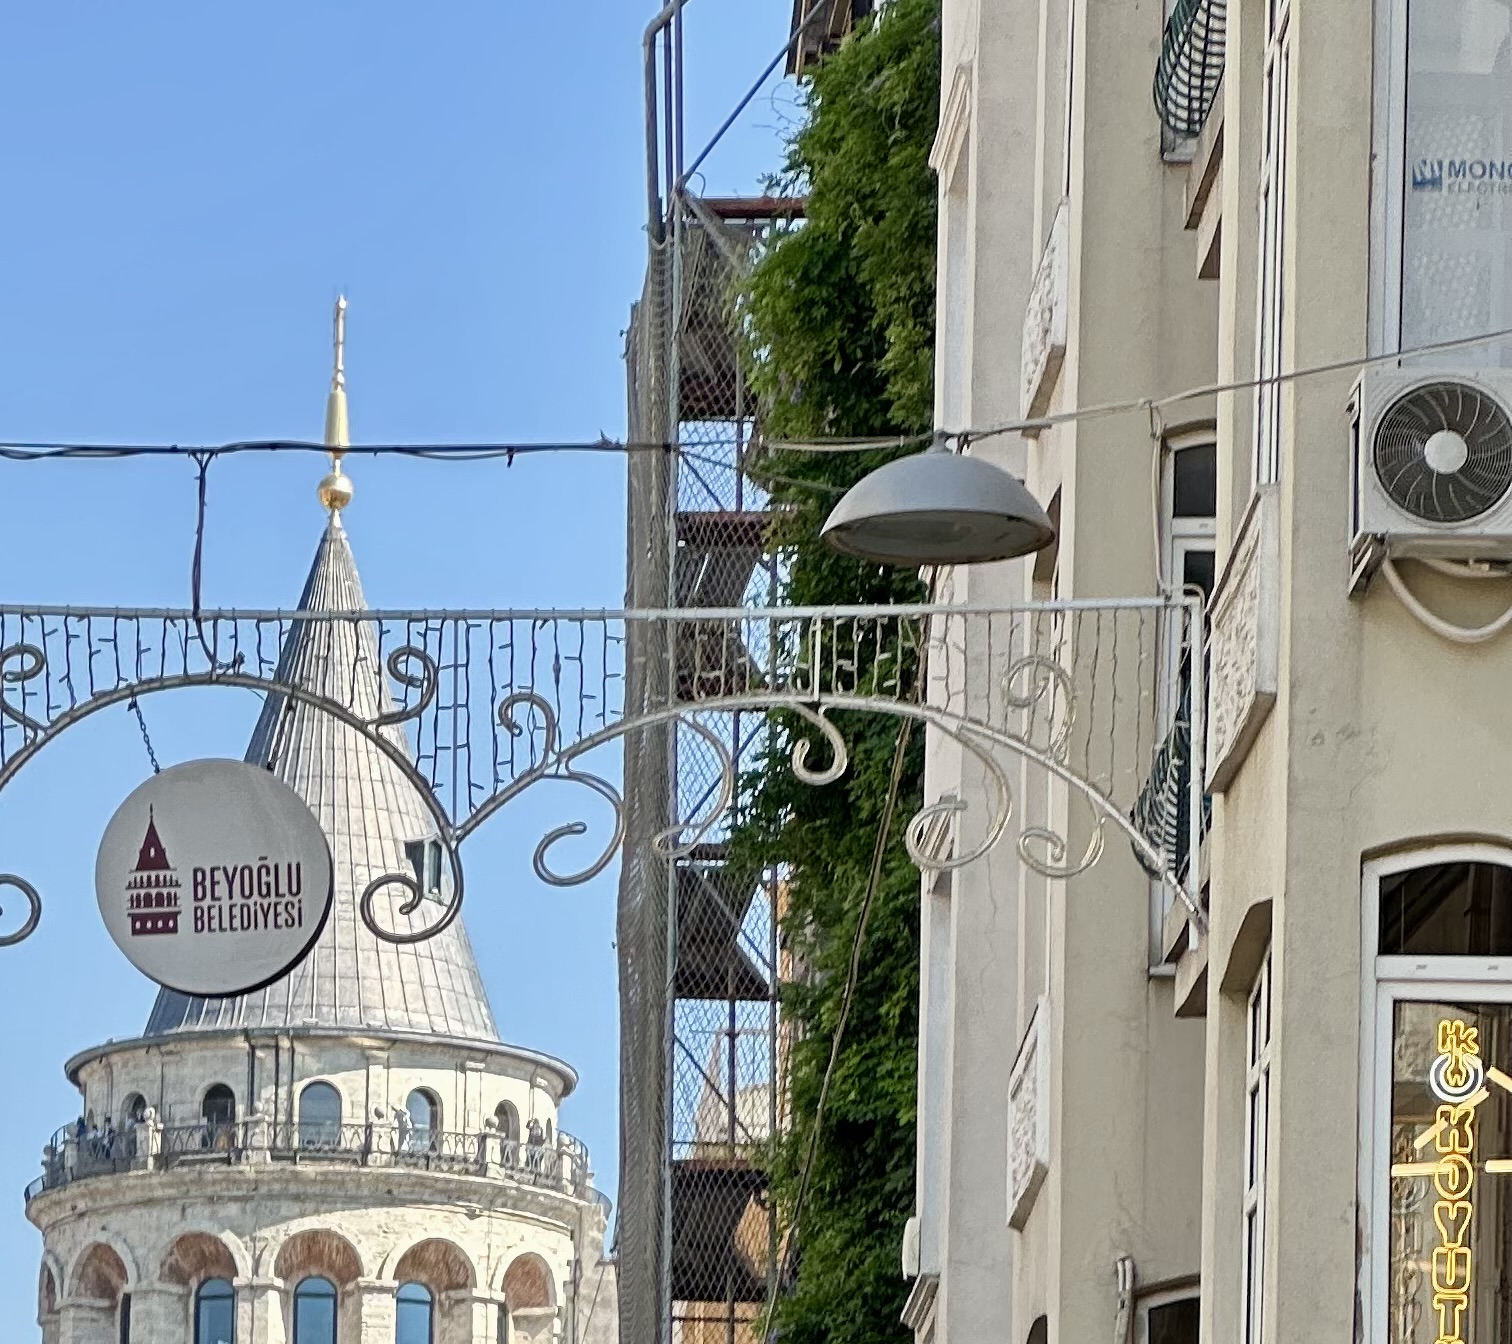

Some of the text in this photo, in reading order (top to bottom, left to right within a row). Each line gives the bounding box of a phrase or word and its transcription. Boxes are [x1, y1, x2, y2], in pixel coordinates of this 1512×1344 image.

[1448, 159, 1512, 180] MON
[192, 856, 302, 902] BEYOĞLU
[193, 899, 303, 934] BELEDİYESİ
